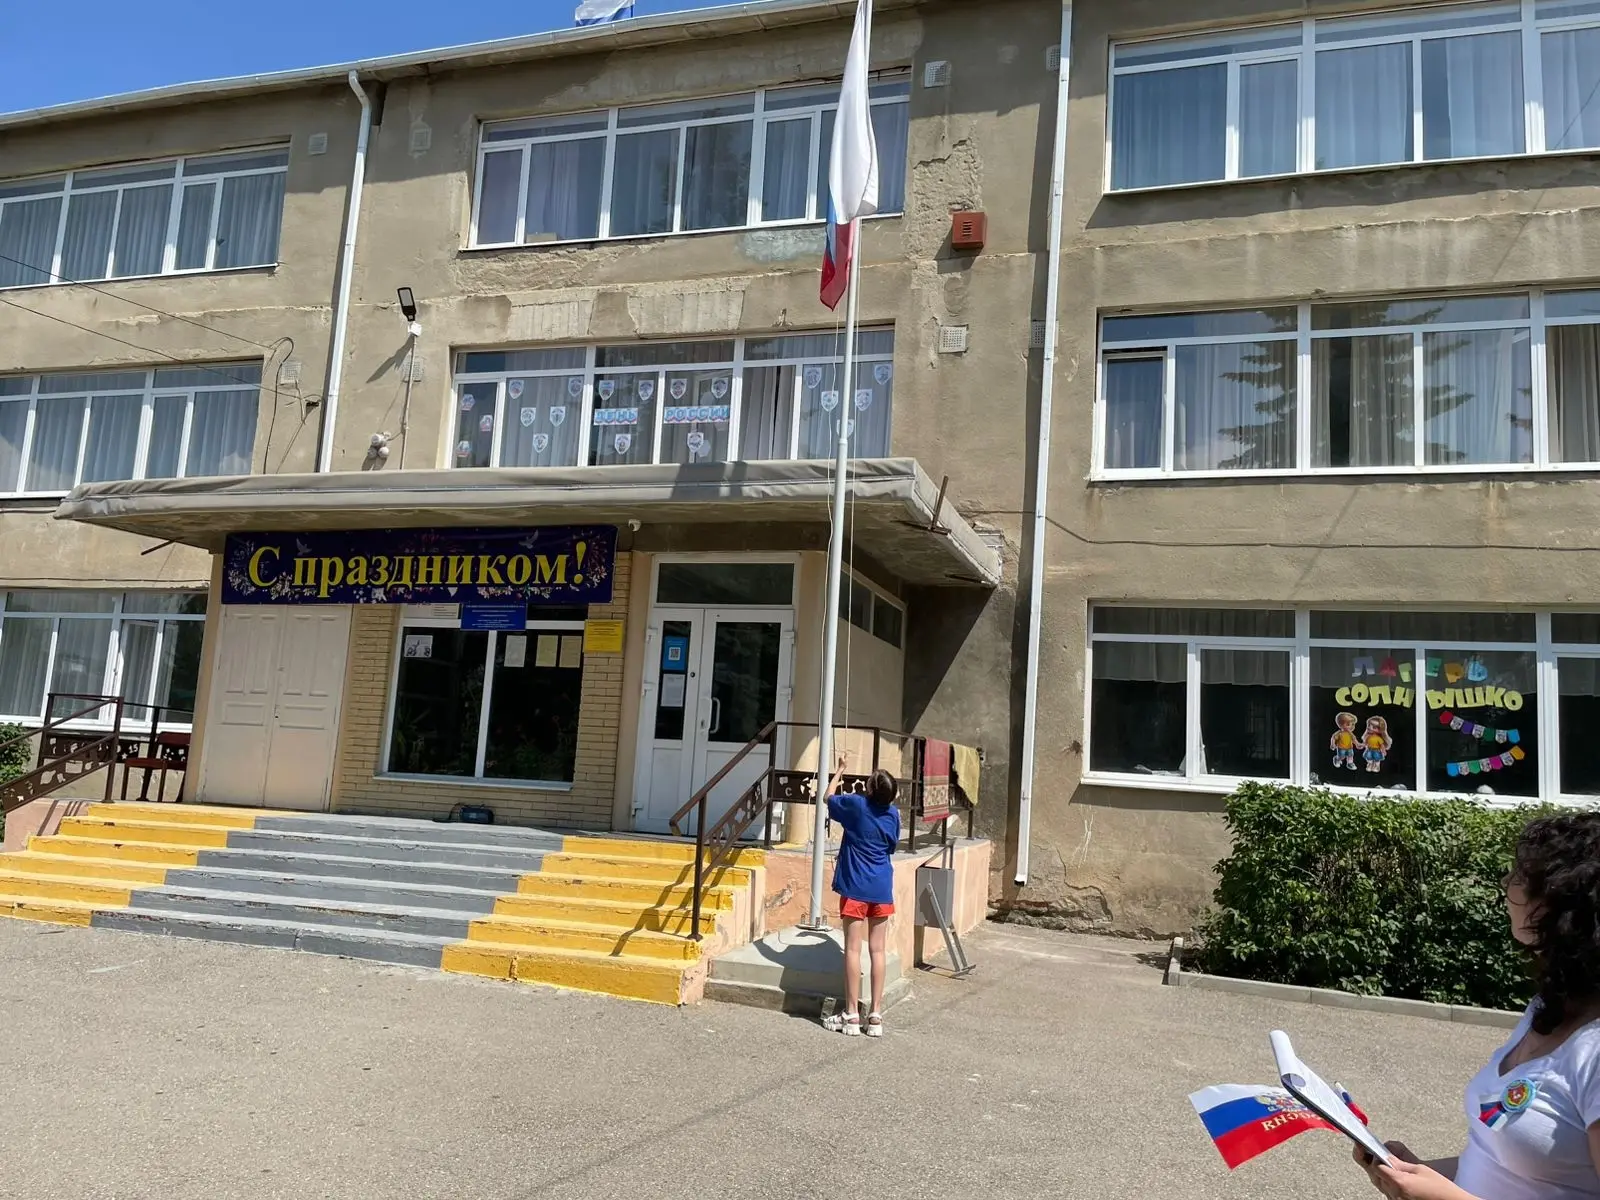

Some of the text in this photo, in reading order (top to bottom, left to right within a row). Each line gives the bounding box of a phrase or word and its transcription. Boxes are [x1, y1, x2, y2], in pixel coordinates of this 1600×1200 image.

[249, 541, 586, 598] С праздником!
[1352, 656, 1488, 683] ЛАГЕРЬ
[1335, 683, 1523, 711] СОЛНЫШКО
